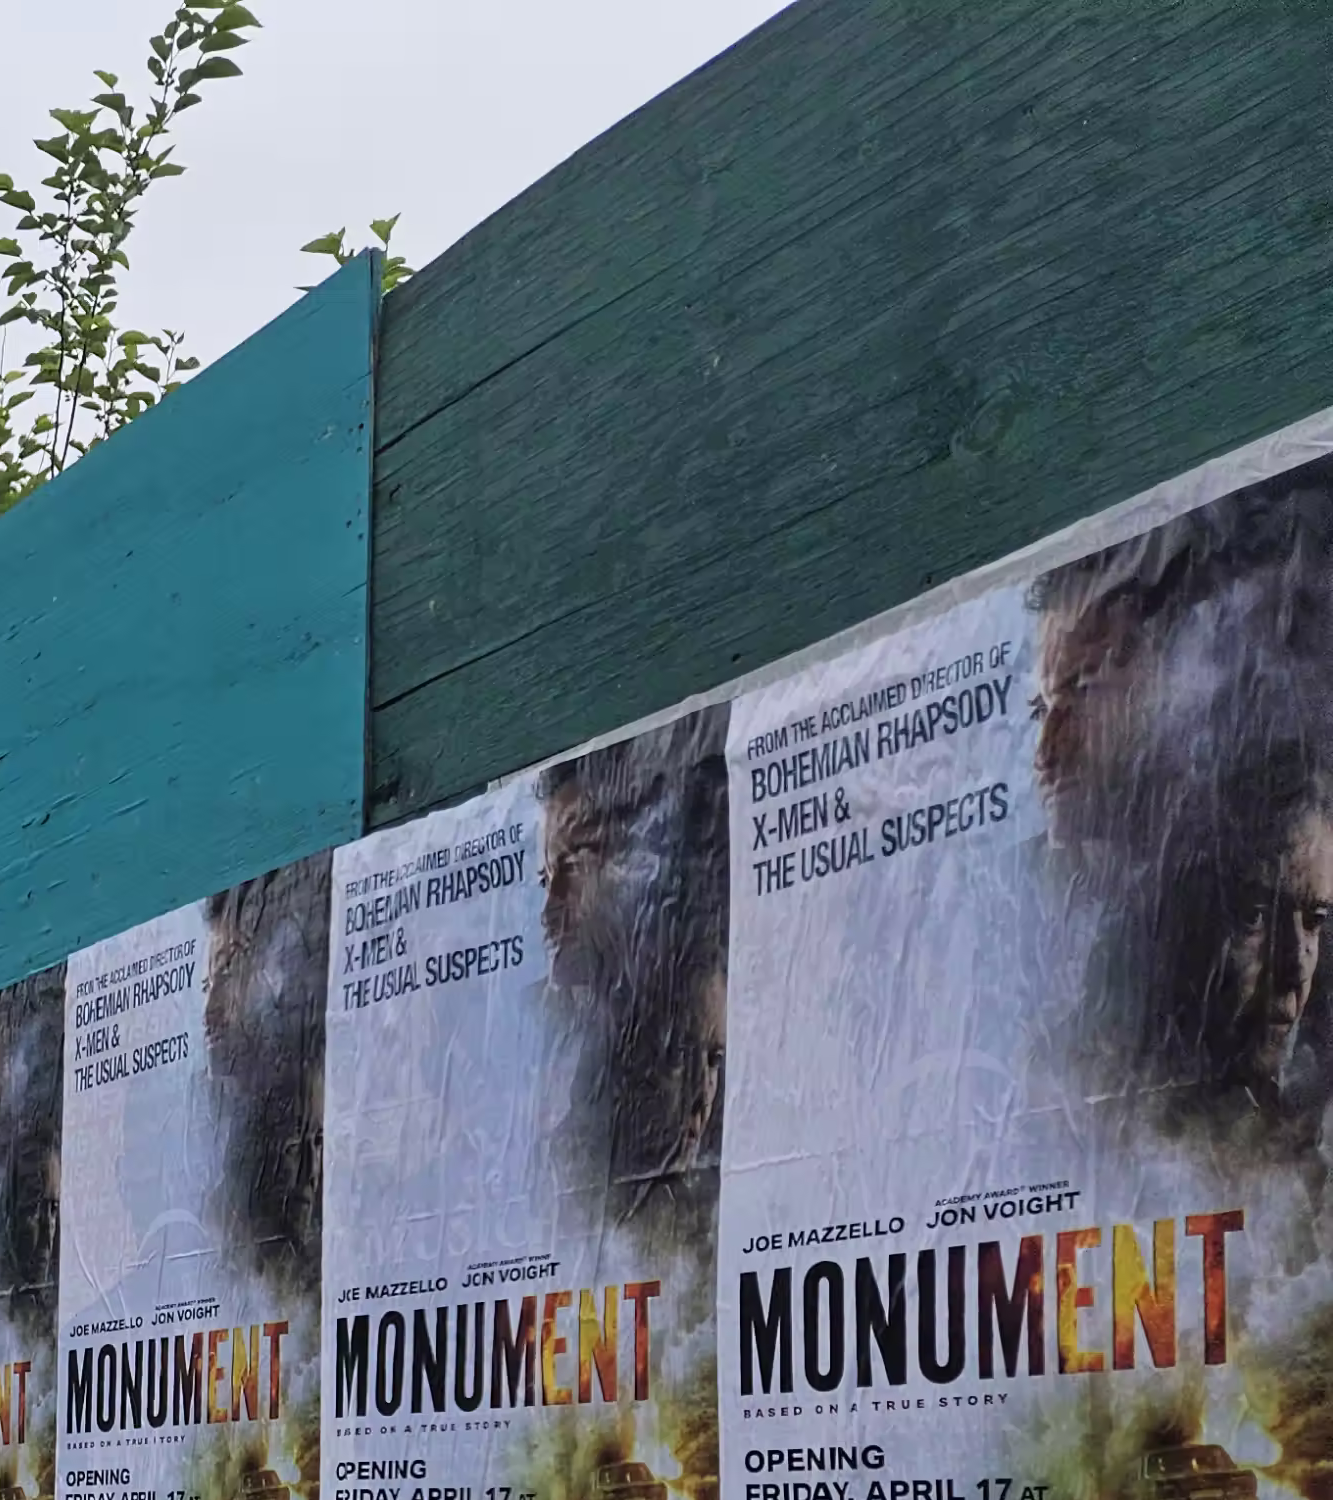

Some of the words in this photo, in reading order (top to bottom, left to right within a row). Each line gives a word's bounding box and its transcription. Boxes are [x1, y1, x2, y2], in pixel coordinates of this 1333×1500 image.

[747, 728, 788, 760] FROM
[791, 715, 818, 744] THE
[821, 682, 907, 734] ACCLAIMED
[911, 651, 984, 700] DIRECTOR
[989, 640, 1013, 668] OF
[751, 726, 870, 804] BOHEMIAN
[877, 674, 1013, 760] RHAPSODY
[753, 792, 829, 852] X-MEN
[834, 786, 851, 824] &
[753, 852, 796, 896] THE
[801, 826, 875, 882] USUAL
[881, 782, 1009, 857] SUSPECTS
[132, 961, 197, 1010] RHAPSODY
[424, 935, 524, 988] SUSPECTS
[926, 1206, 976, 1230] JON
[983, 1190, 1081, 1220] VOIGHT
[1029, 1180, 1070, 1193] WINNER
[743, 1234, 783, 1254] JOE
[787, 1216, 905, 1248] MAZZELLO
[461, 1266, 495, 1288] JON
[499, 1262, 561, 1283] VOIGHT
[739, 1209, 1245, 1396] MONUMENT
[335, 1280, 661, 1418] MONUMENT
[66, 1320, 289, 1435] MONUMENT
[65, 1468, 131, 1487] OPENING
[335, 1459, 427, 1482] OPENING
[745, 1444, 885, 1473] OPENING
